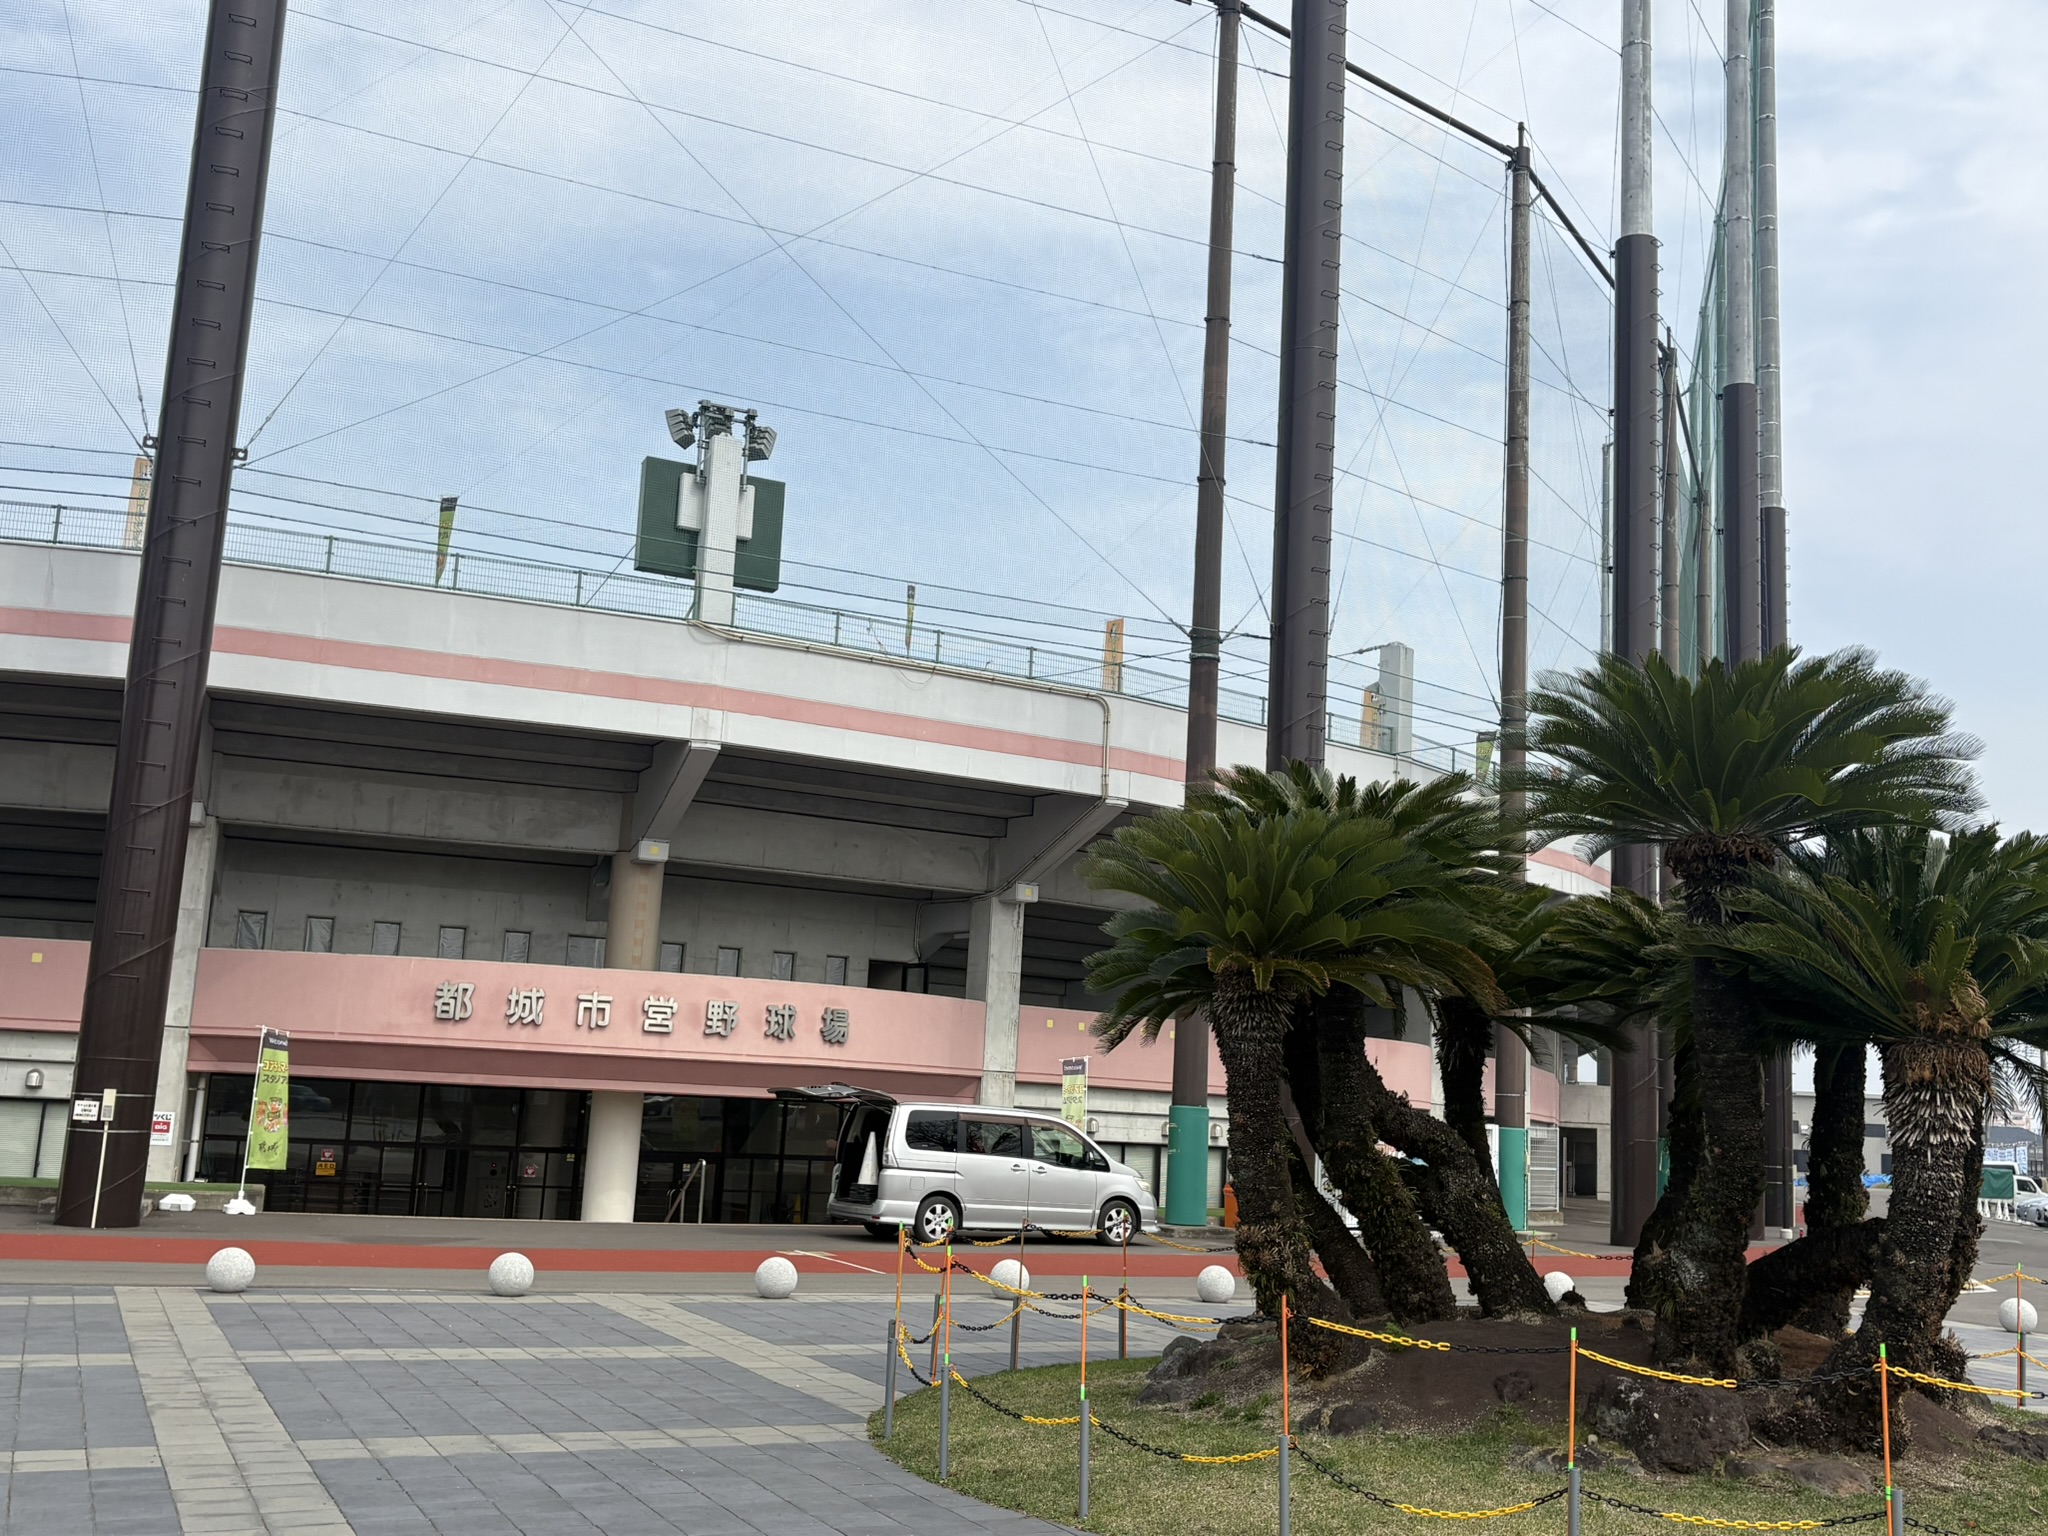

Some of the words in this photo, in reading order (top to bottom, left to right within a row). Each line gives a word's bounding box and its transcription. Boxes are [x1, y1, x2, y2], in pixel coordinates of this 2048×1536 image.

[434, 980, 851, 1045] 都城市営野球場
